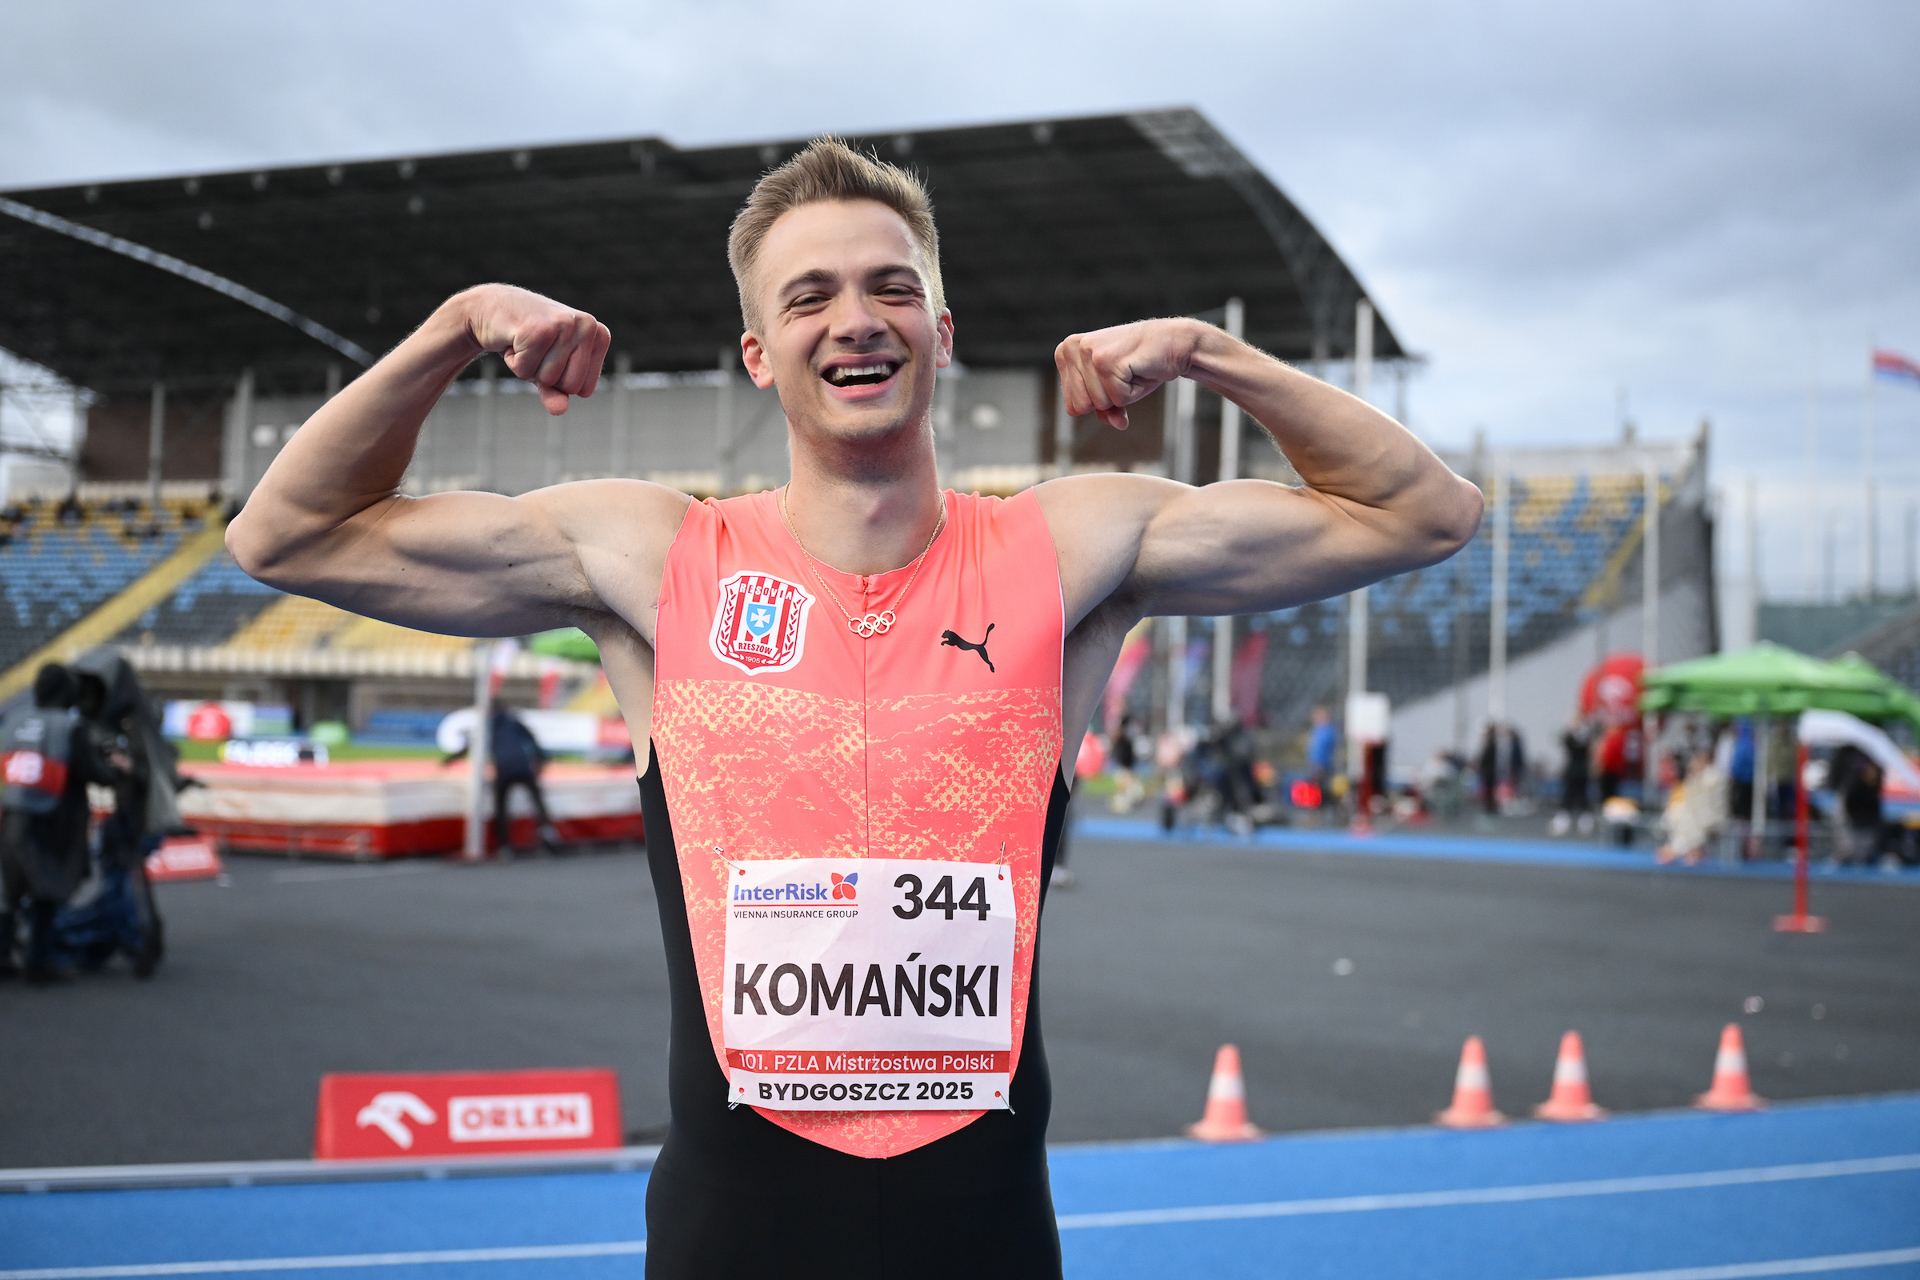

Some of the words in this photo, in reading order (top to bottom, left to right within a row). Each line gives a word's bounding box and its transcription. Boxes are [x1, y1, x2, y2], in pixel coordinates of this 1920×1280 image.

[740, 583, 792, 600] RESOVIA
[745, 655, 761, 664] 1905
[733, 883, 828, 901] InterRisk
[892, 873, 991, 921] 344
[733, 910, 769, 919] VIENNA
[770, 910, 824, 919] INSURANCE
[826, 910, 859, 919] GROUP
[733, 952, 1000, 1017] KOMAŃSKI
[739, 1053, 768, 1071] 101.
[774, 1054, 819, 1071] PZLA
[825, 1053, 937, 1071] Mistrzostwa
[942, 1053, 995, 1071] Polski
[758, 1082, 910, 1101] BYDGOSZCZ
[916, 1081, 974, 1100] 2025
[461, 1105, 577, 1130] ORLEN
